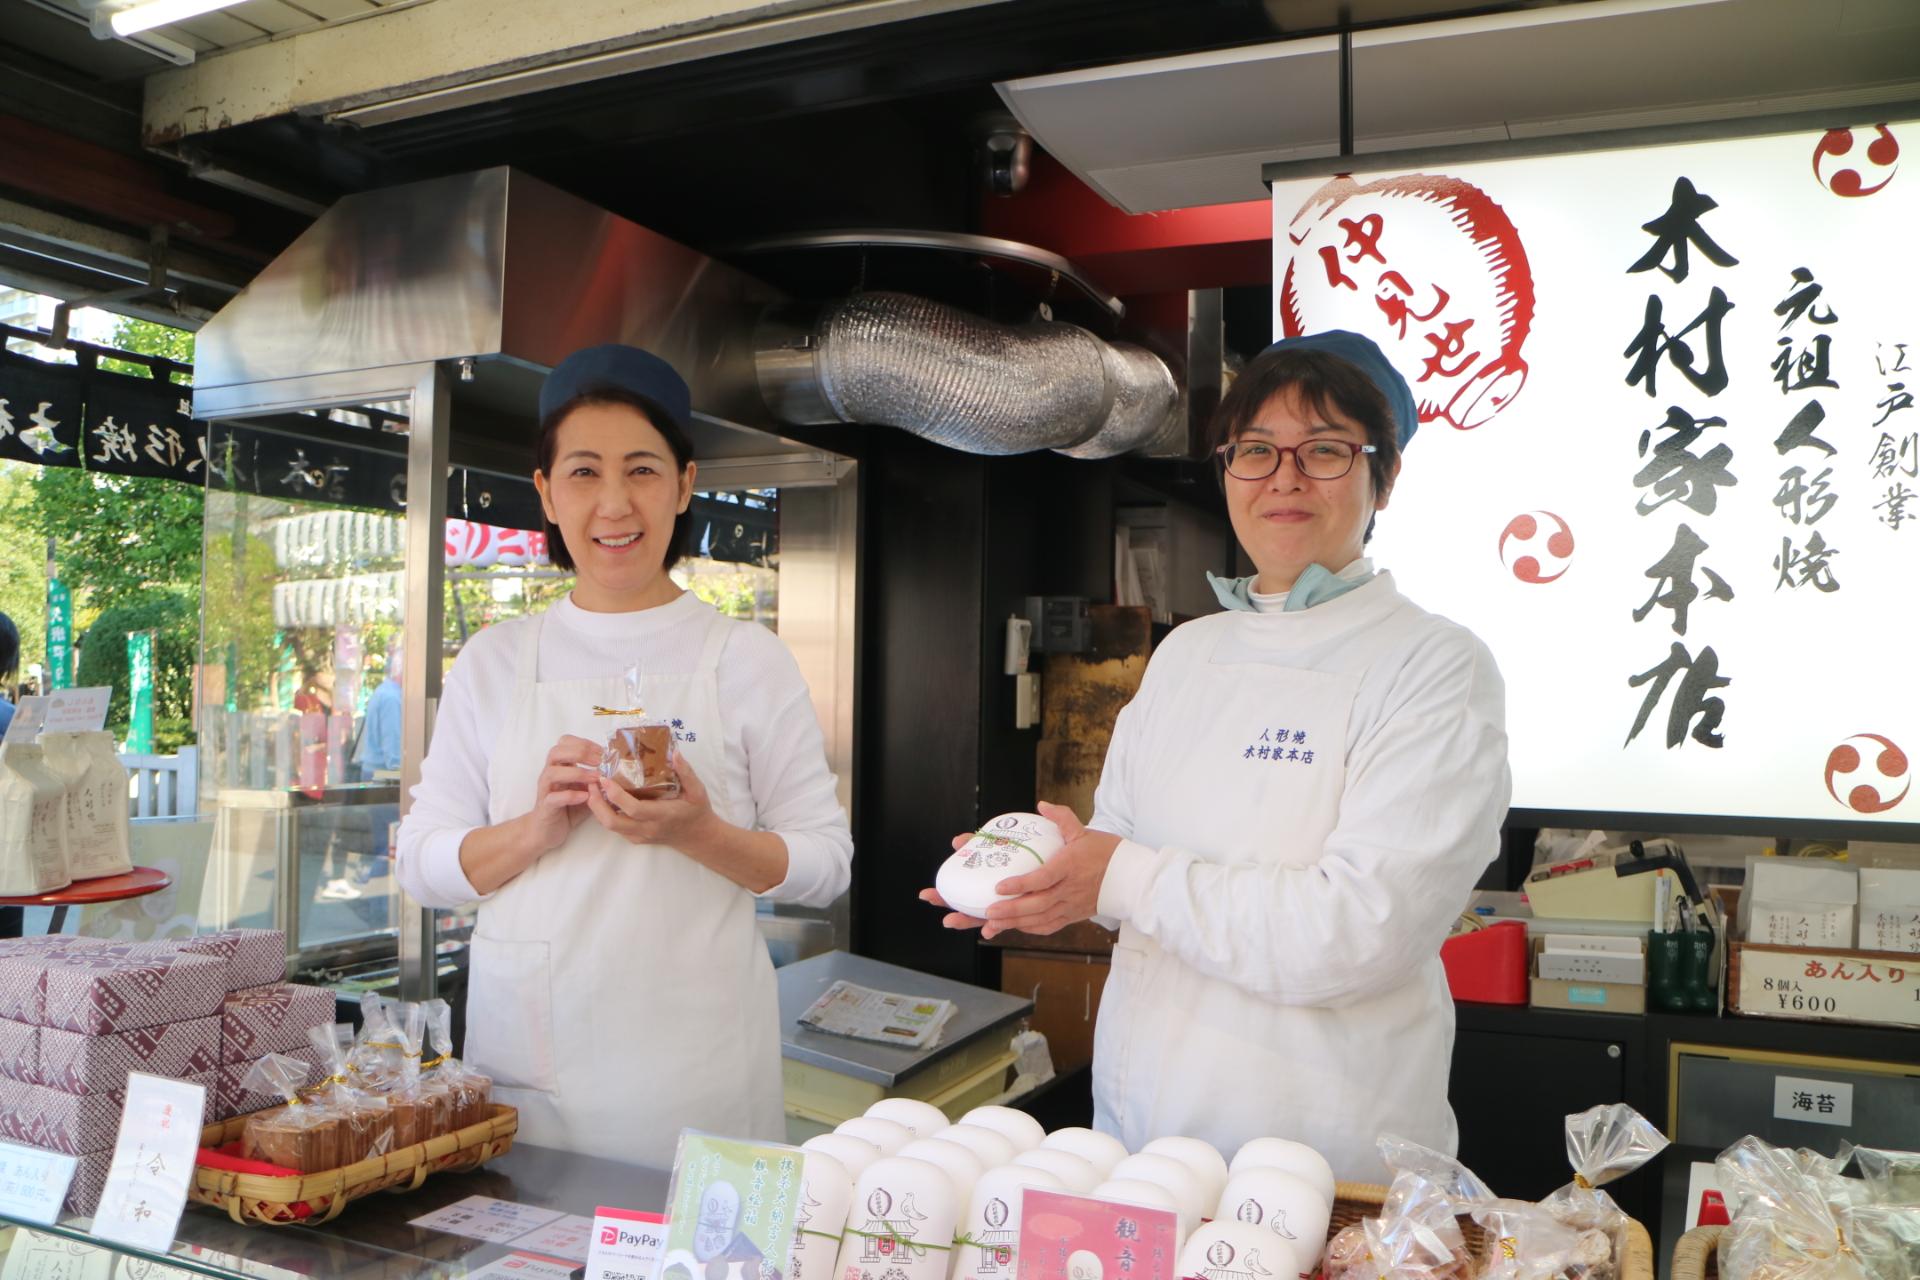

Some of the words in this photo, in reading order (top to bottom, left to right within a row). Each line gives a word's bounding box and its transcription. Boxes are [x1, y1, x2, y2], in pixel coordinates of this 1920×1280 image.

[1318, 213, 1480, 382] 仲見世
[1771, 267, 1840, 593] 元祖人形焼
[1869, 341, 1919, 530] 江戸創業
[1624, 176, 1740, 749] 木村家本店
[1259, 727, 1306, 745] 人形焼
[1243, 744, 1314, 764] 木村家本店
[1804, 960, 1905, 984] あん入り
[1778, 994, 1836, 1013] ¥600
[1792, 1090, 1836, 1113] 海苔
[619, 1231, 664, 1249] PayPay
